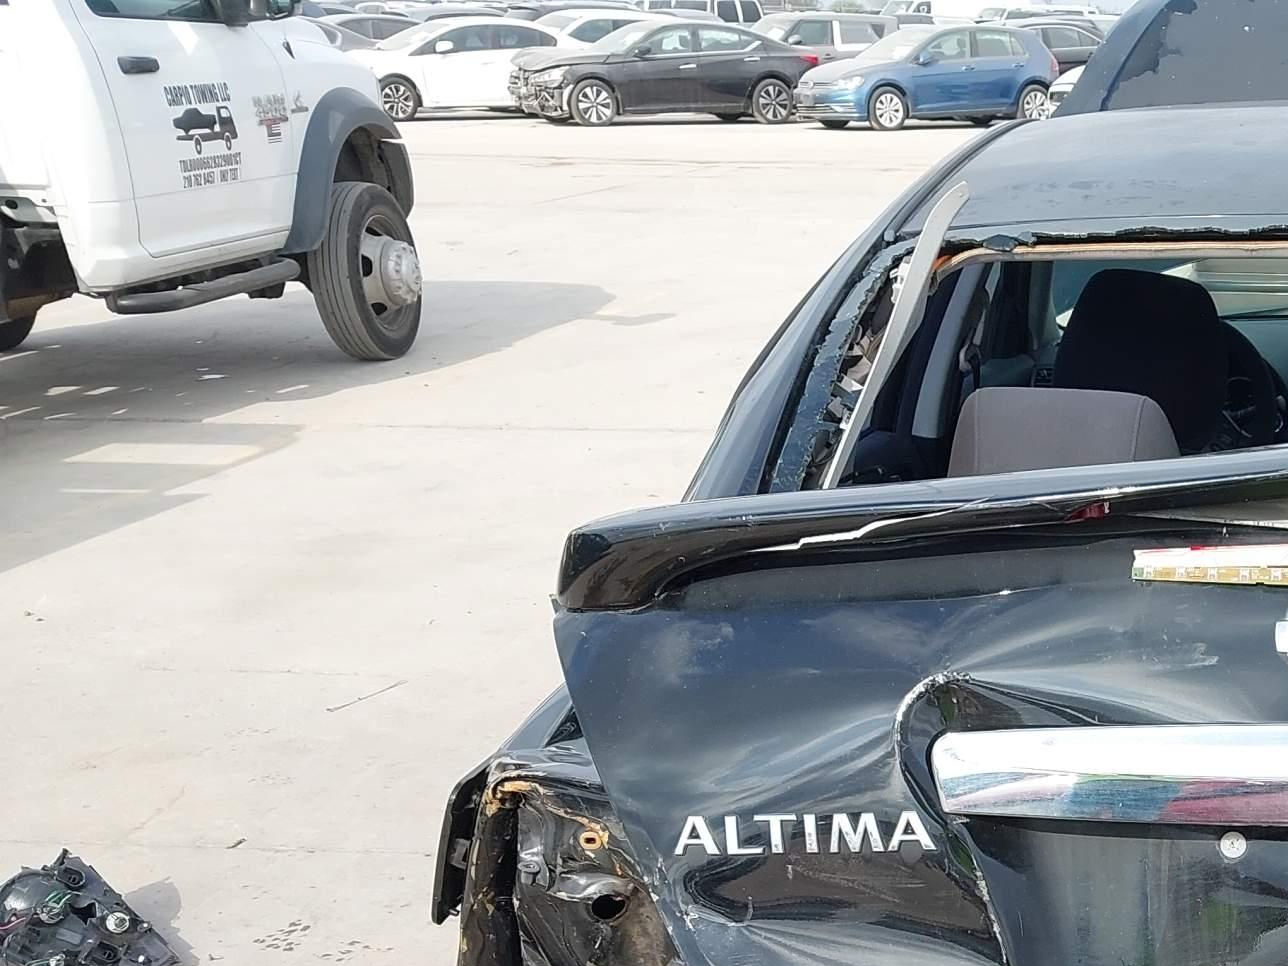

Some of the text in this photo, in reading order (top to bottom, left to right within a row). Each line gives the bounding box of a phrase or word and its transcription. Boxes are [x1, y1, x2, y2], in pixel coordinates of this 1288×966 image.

[163, 81, 231, 107] CARPIO TOWING LLC
[673, 810, 936, 857] ALTIMA
